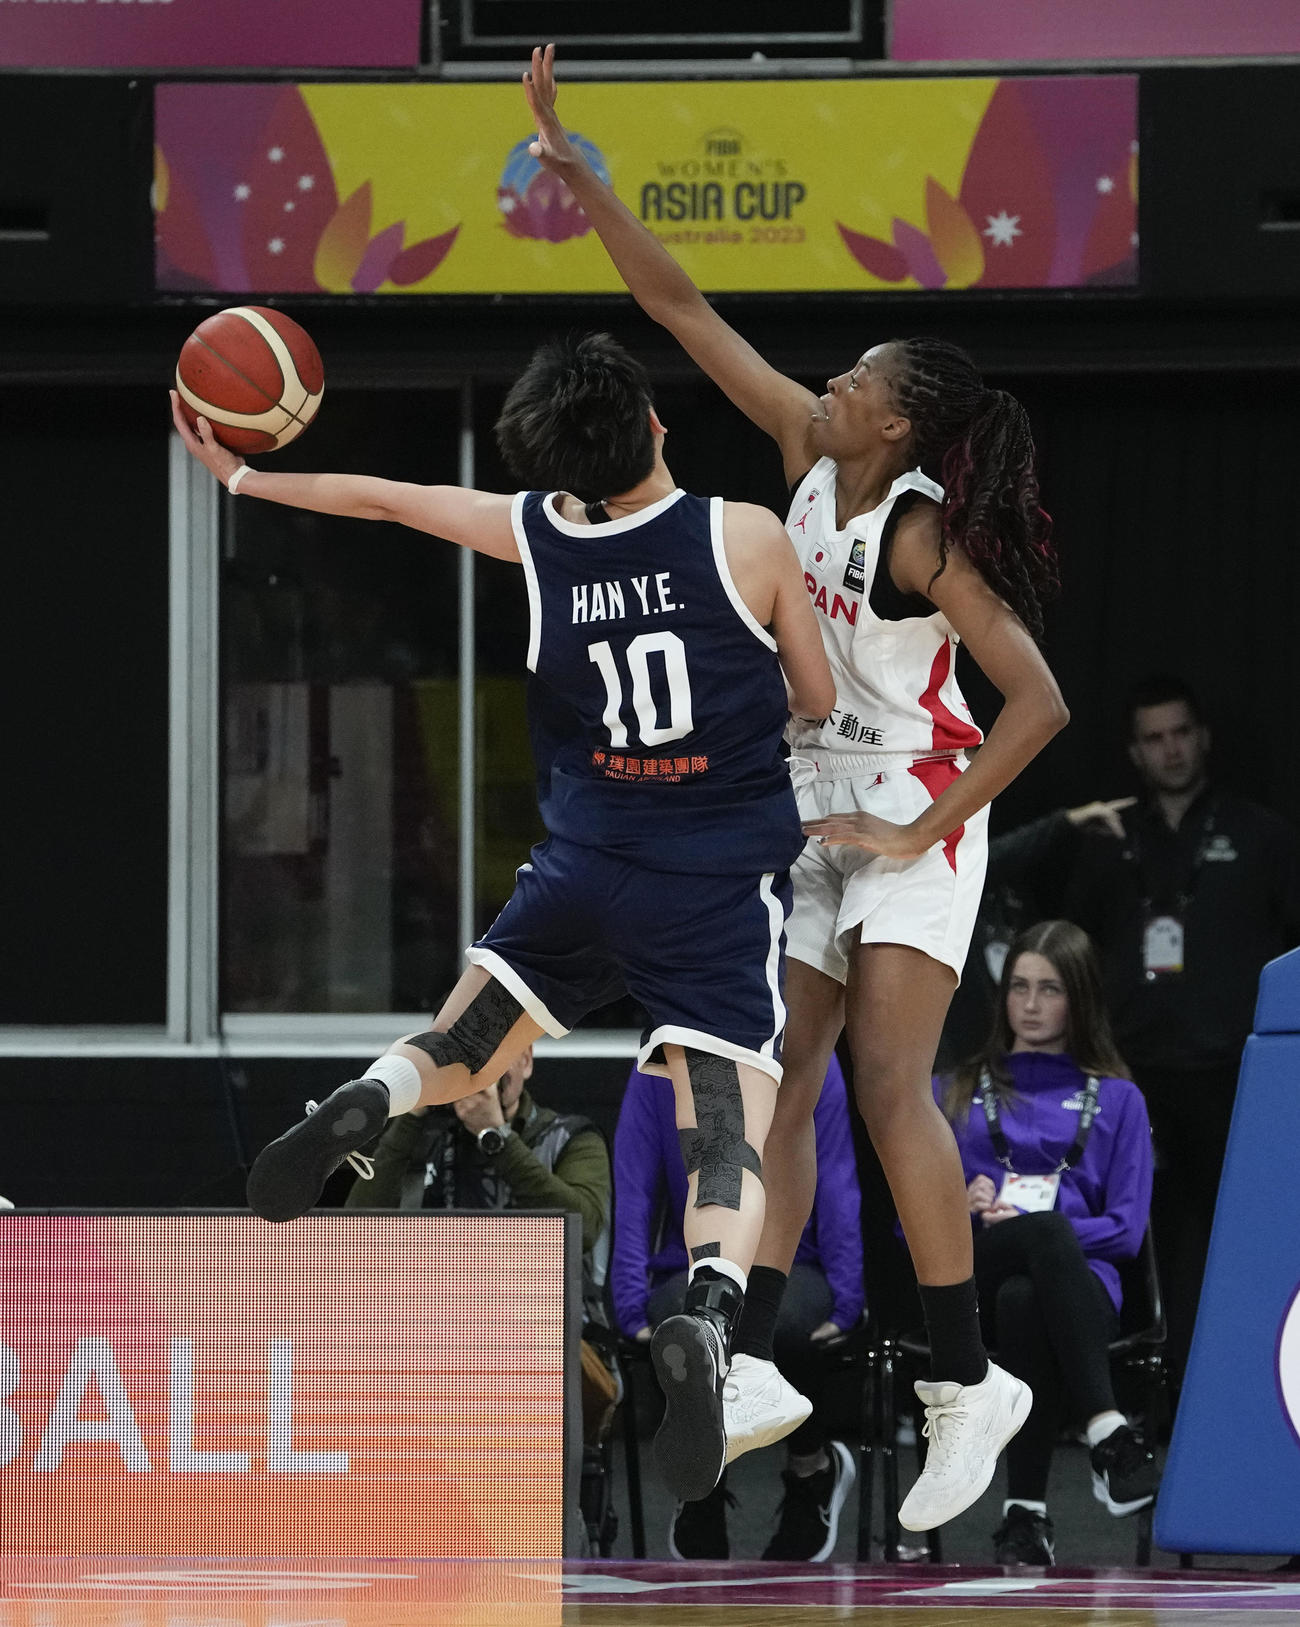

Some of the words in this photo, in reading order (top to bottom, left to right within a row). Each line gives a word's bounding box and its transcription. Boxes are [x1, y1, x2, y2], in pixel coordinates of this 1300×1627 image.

[640, 182, 724, 221] ASIA
[734, 181, 807, 221] CUP
[656, 229, 743, 245] ustralia
[751, 226, 806, 244] 2023
[572, 580, 626, 625] HAN
[630, 571, 686, 617] Y.E.
[804, 571, 858, 627] PAN
[587, 630, 695, 749] 10
